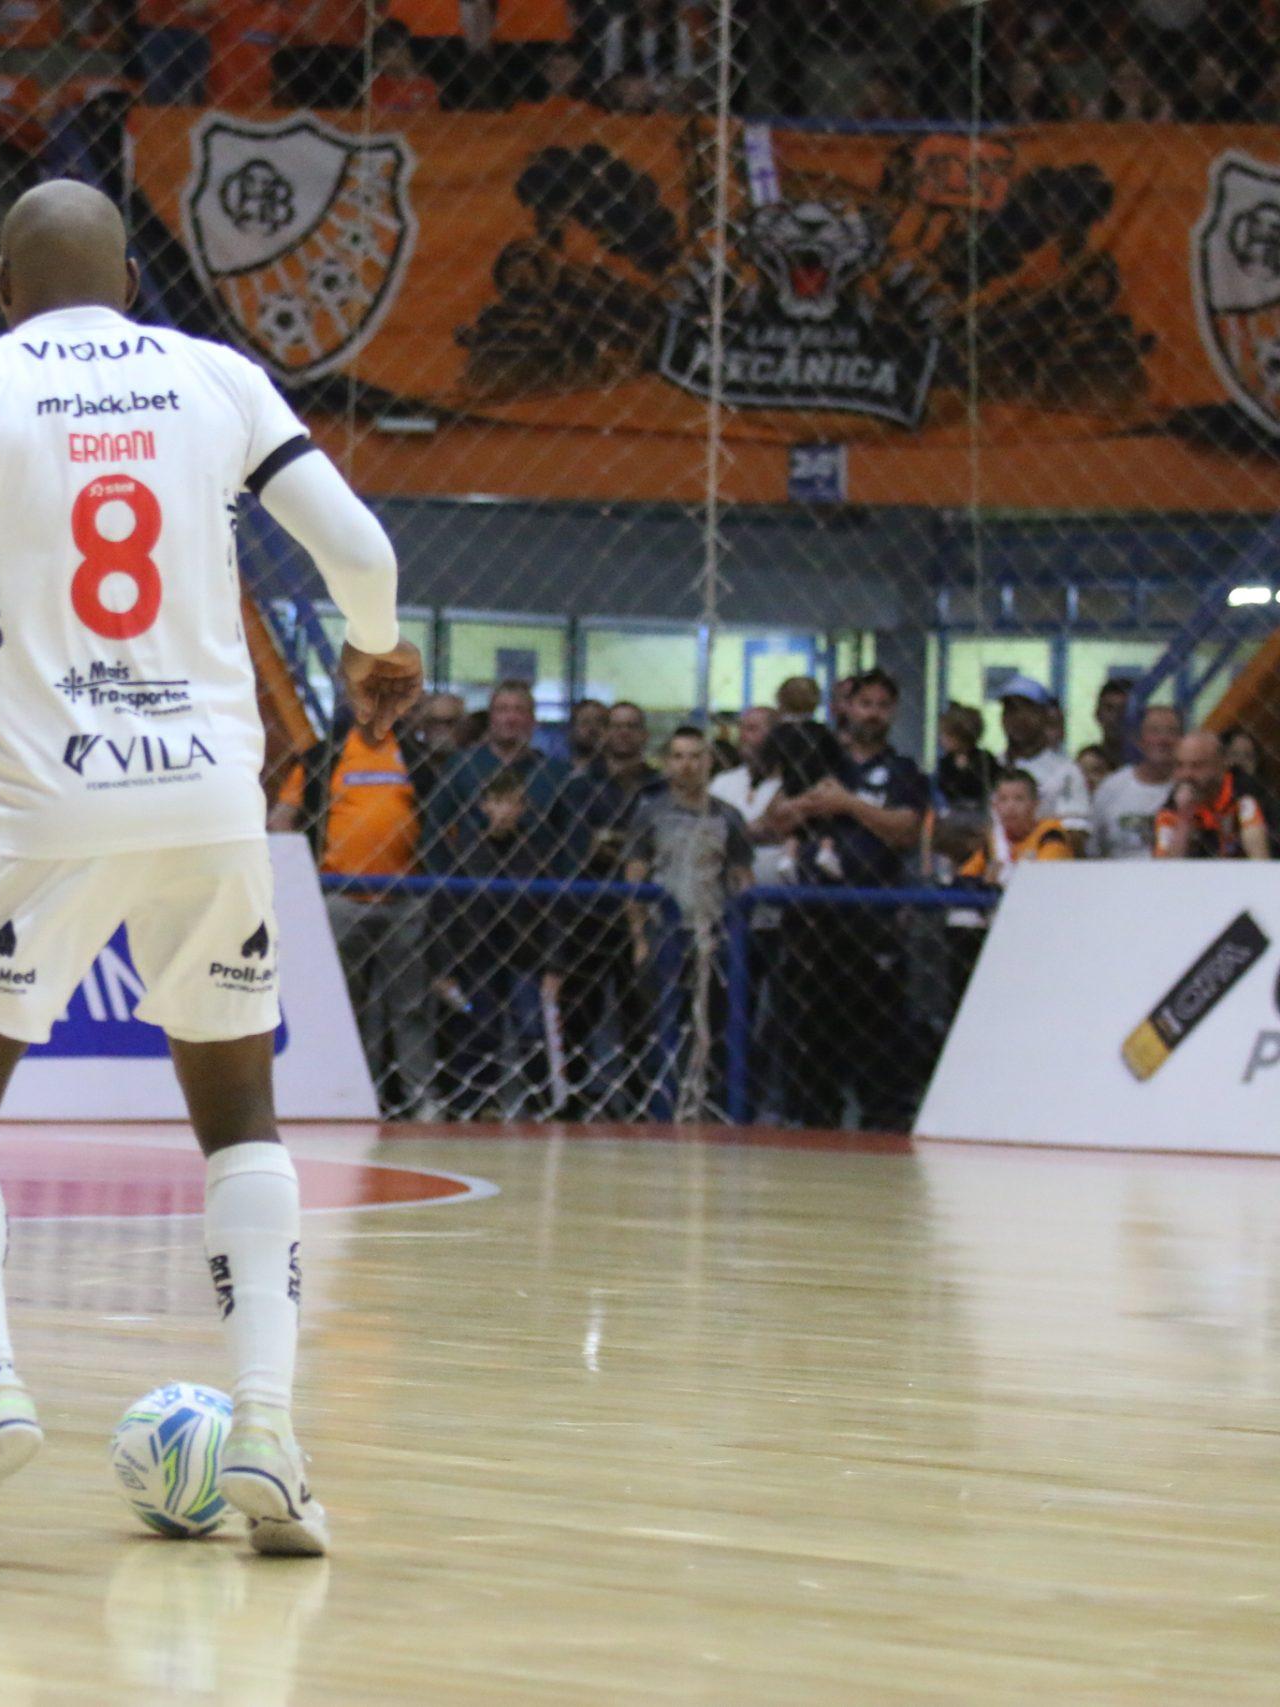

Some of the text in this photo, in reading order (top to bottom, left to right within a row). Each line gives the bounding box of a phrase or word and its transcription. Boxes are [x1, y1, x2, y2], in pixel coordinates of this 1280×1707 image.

[21, 336, 166, 361] VIQUA
[69, 430, 156, 463] ERNANI
[71, 474, 162, 640] 8
[89, 660, 130, 680] Mais
[105, 733, 217, 773] VILA
